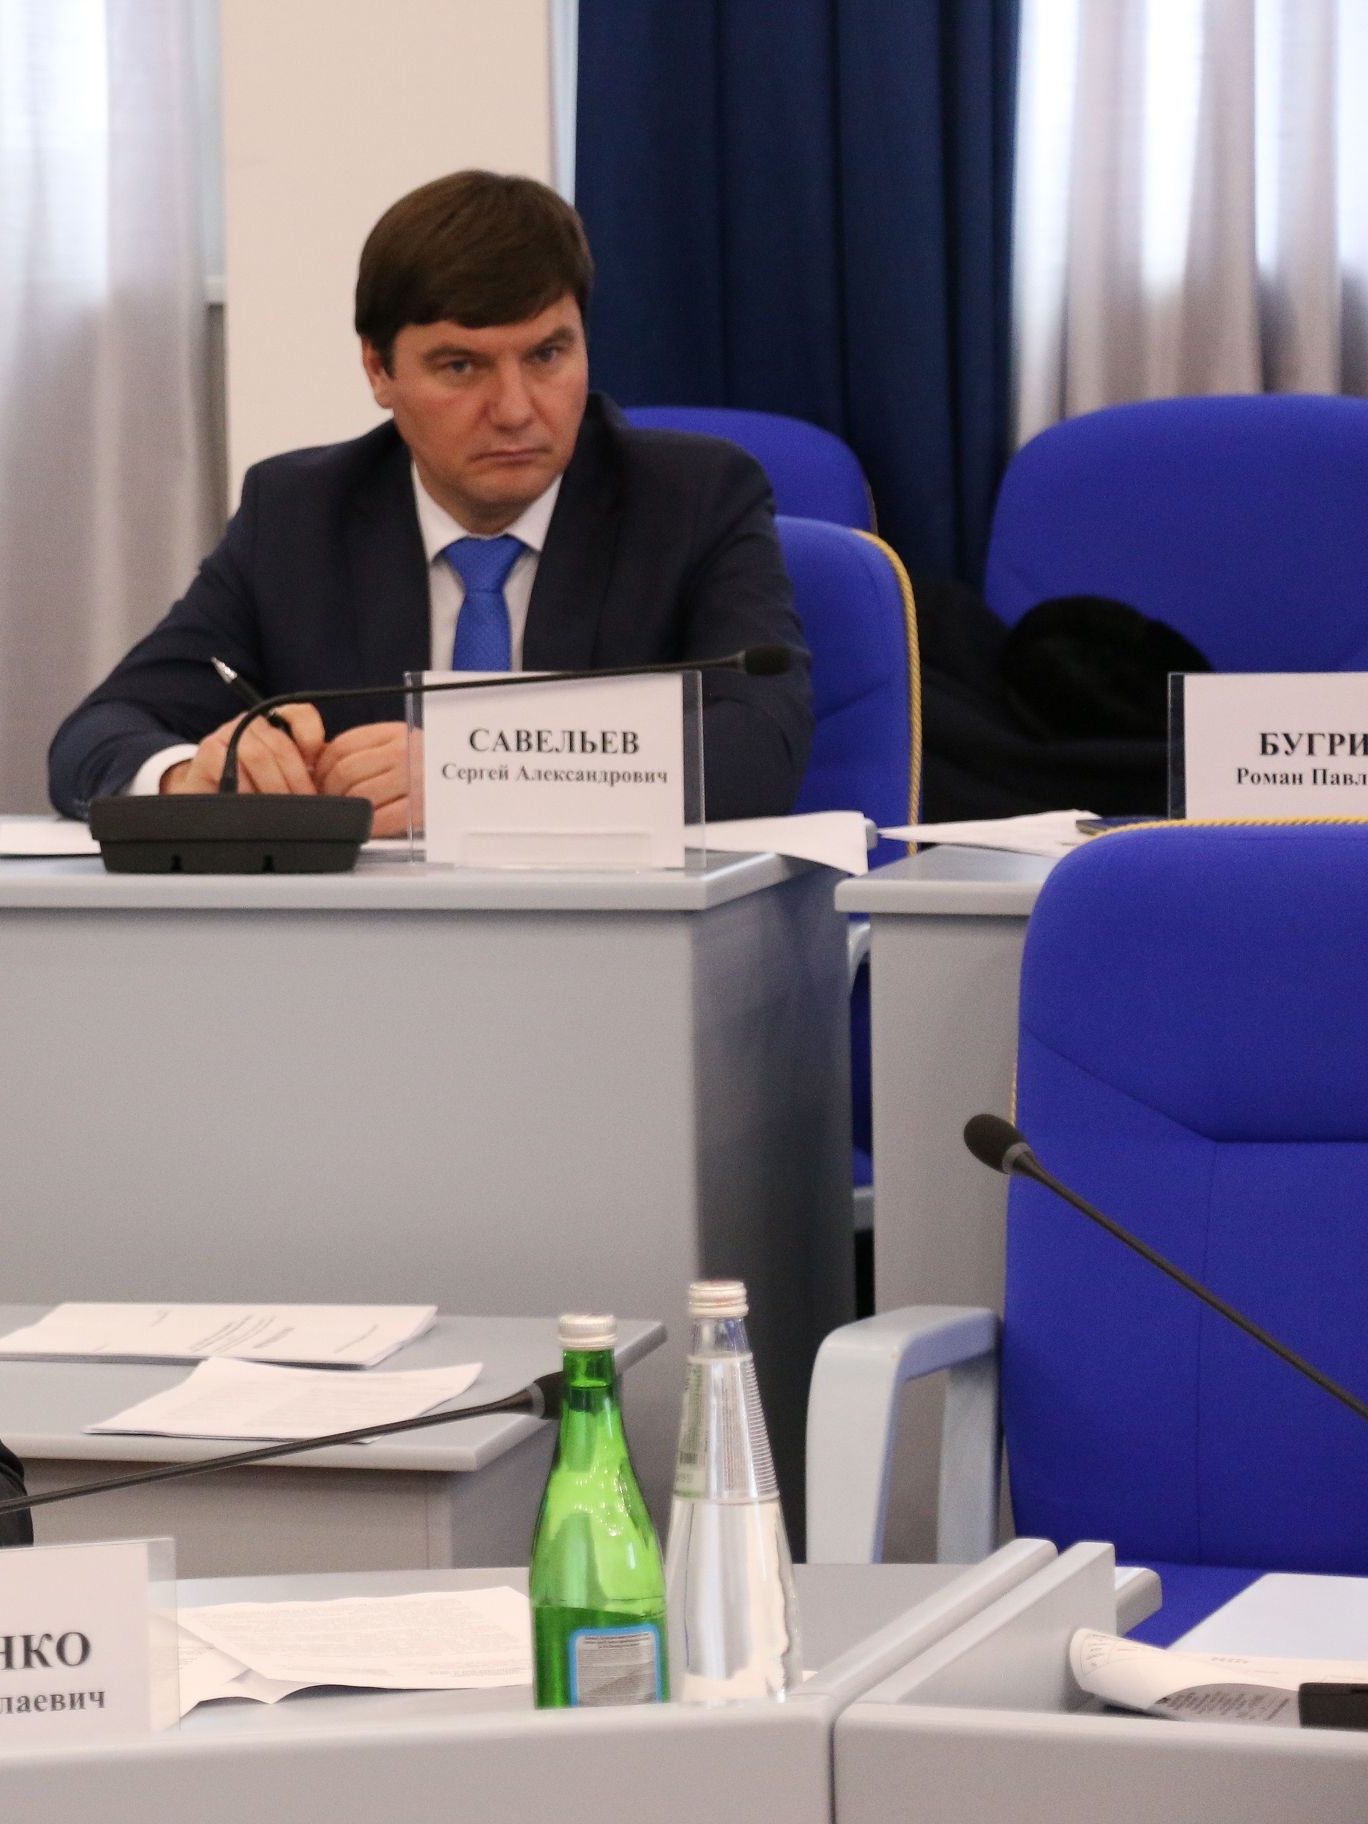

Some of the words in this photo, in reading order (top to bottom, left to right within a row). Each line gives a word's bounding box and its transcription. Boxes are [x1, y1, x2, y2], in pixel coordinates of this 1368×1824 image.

[469, 728, 640, 754] САВЕЛЬЕВ
[1259, 732, 1368, 756] БУГРИ
[442, 763, 509, 784] Сергей
[517, 765, 668, 786] Александрович
[1236, 767, 1303, 785] Роман
[1312, 768, 1368, 785] Павл
